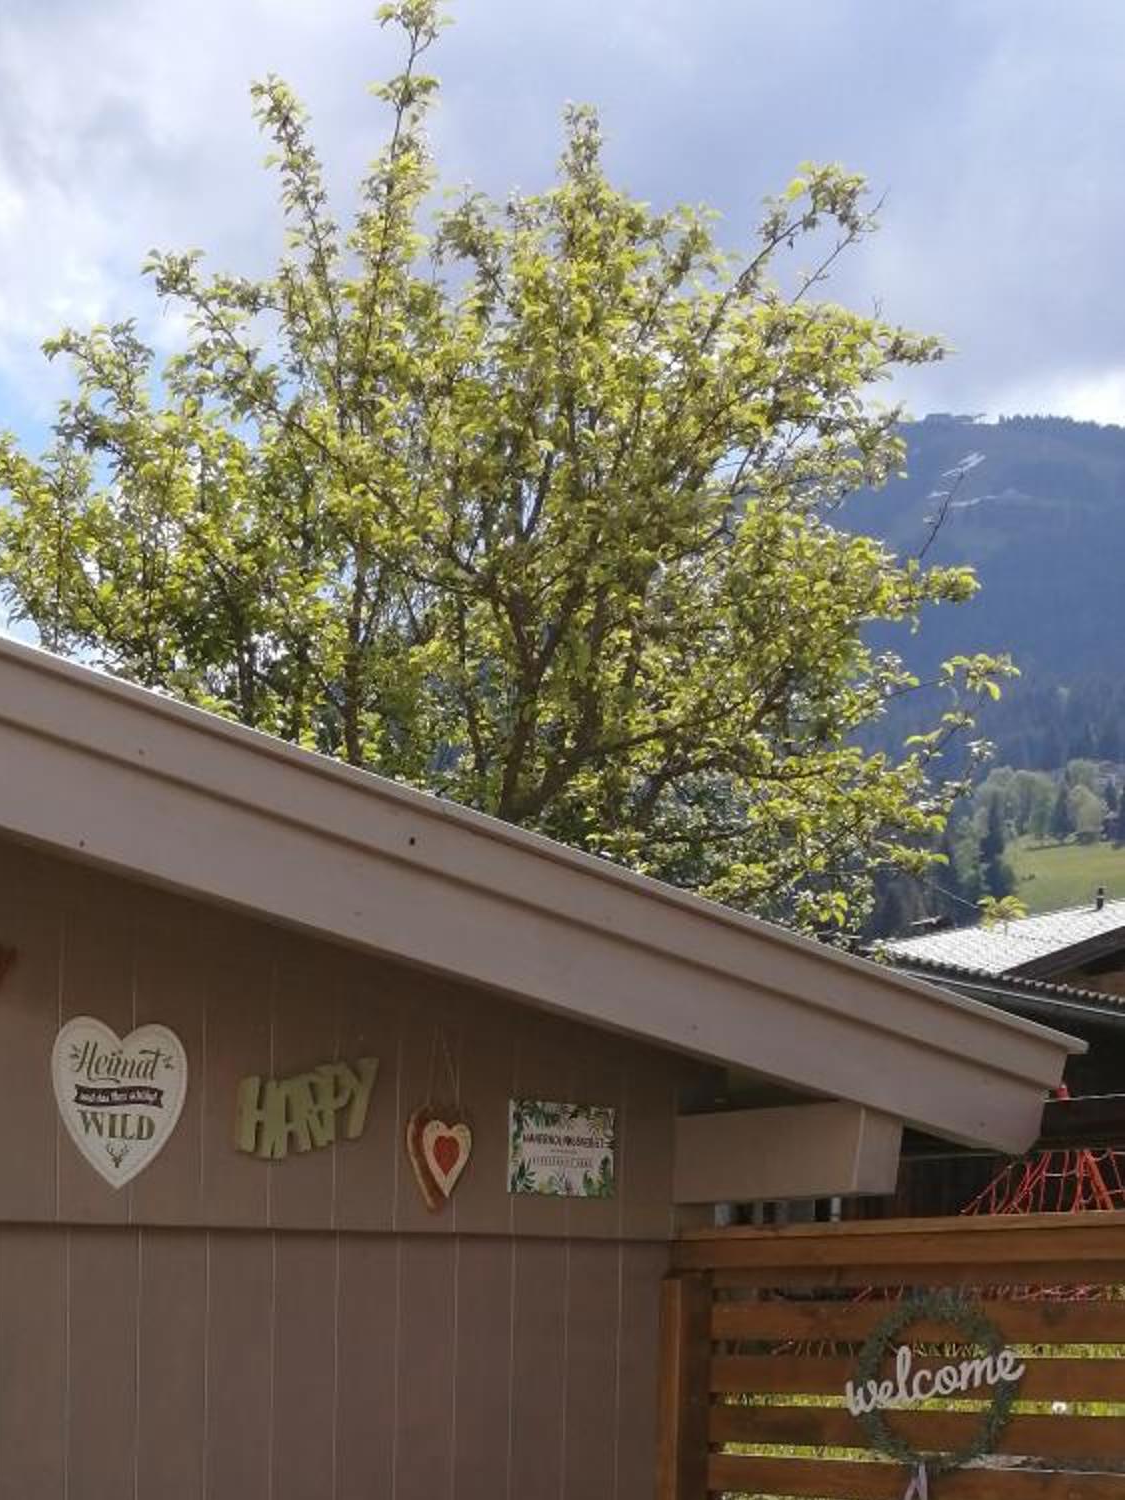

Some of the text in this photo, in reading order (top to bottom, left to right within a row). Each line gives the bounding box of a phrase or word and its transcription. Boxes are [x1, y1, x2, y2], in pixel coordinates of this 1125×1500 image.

[75, 1040, 165, 1084] Heimat
[77, 1110, 157, 1141] WILD
[235, 1057, 379, 1160] HAPPY
[845, 1345, 1027, 1416] welcome
